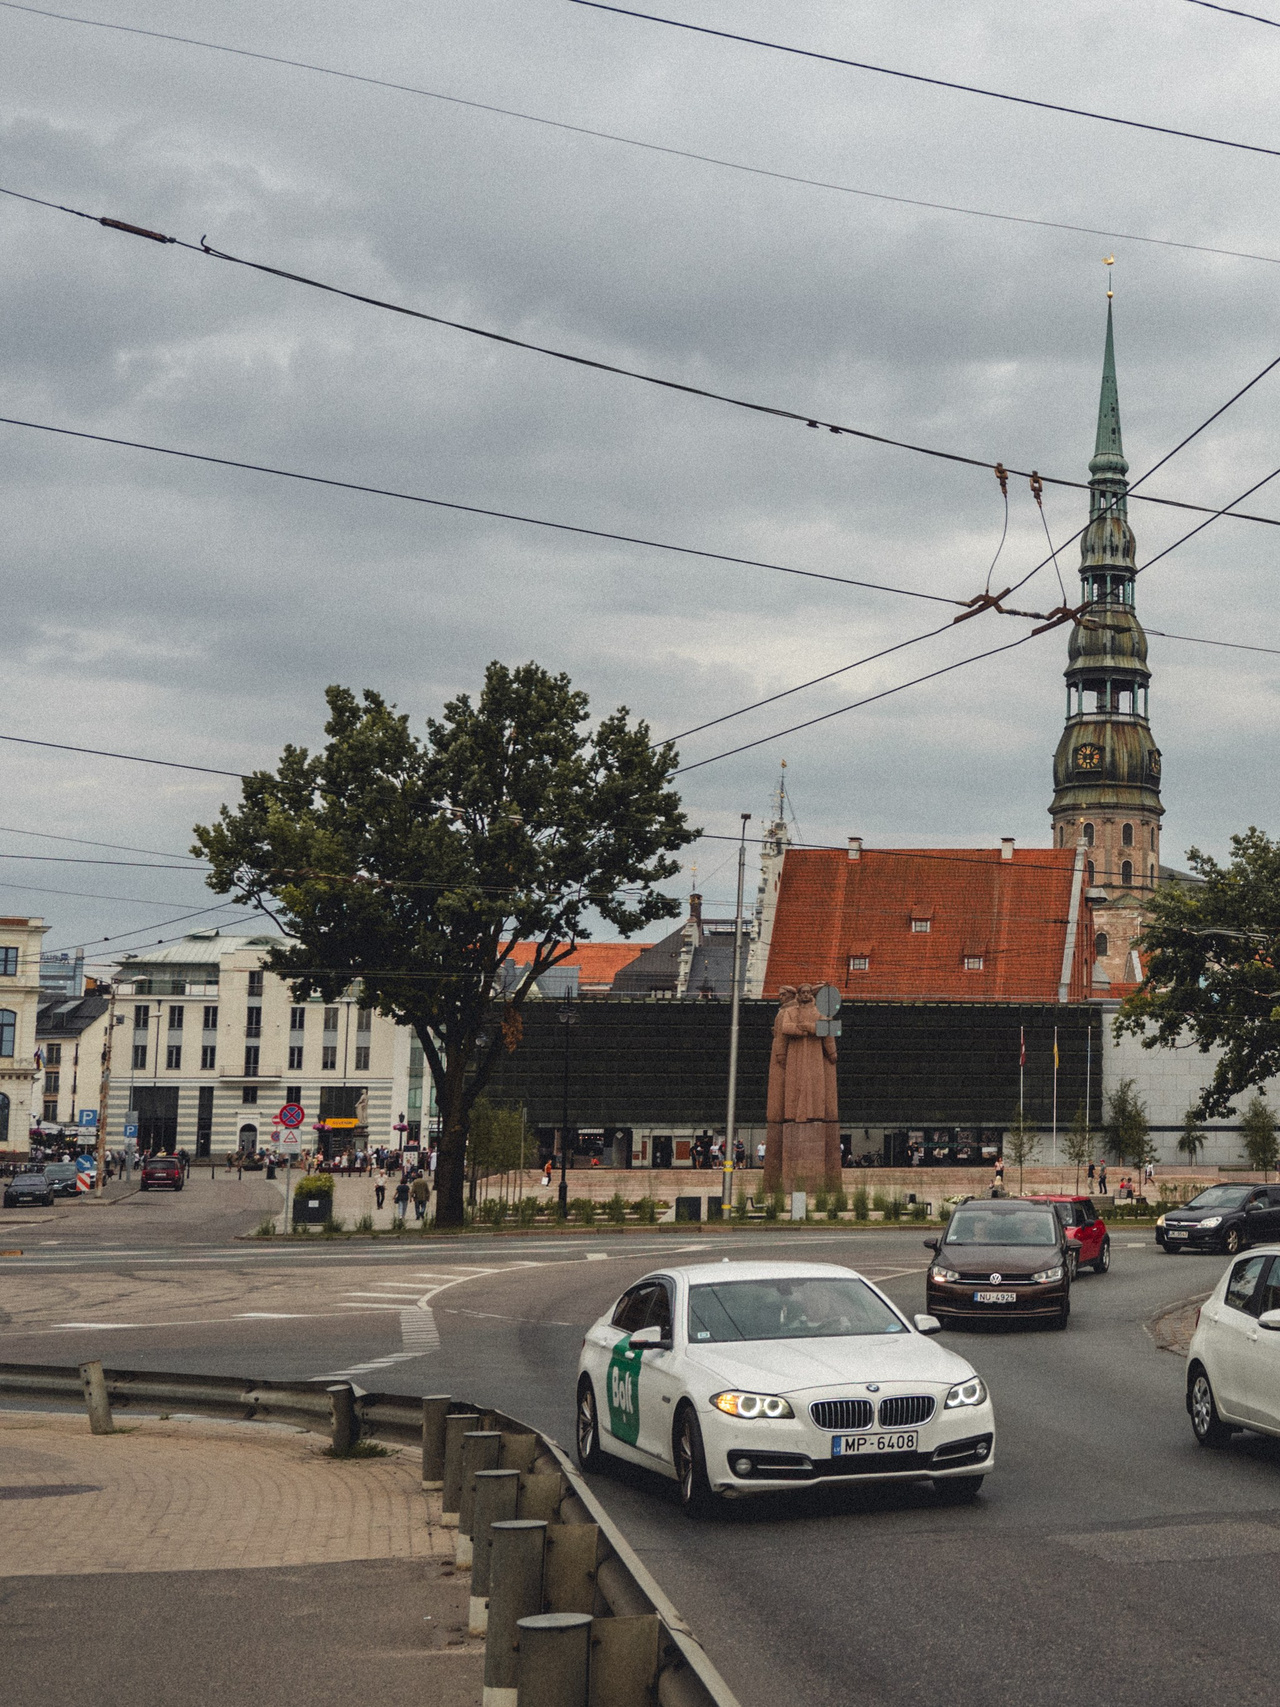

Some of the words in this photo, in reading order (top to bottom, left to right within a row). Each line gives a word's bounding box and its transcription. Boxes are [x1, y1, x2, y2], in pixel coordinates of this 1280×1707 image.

[82, 1111, 93, 1124] P
[126, 1126, 135, 1136] P
[980, 1293, 1015, 1301] NU-4925
[612, 1366, 634, 1414] Bolt
[844, 1434, 914, 1453] MP-6408
